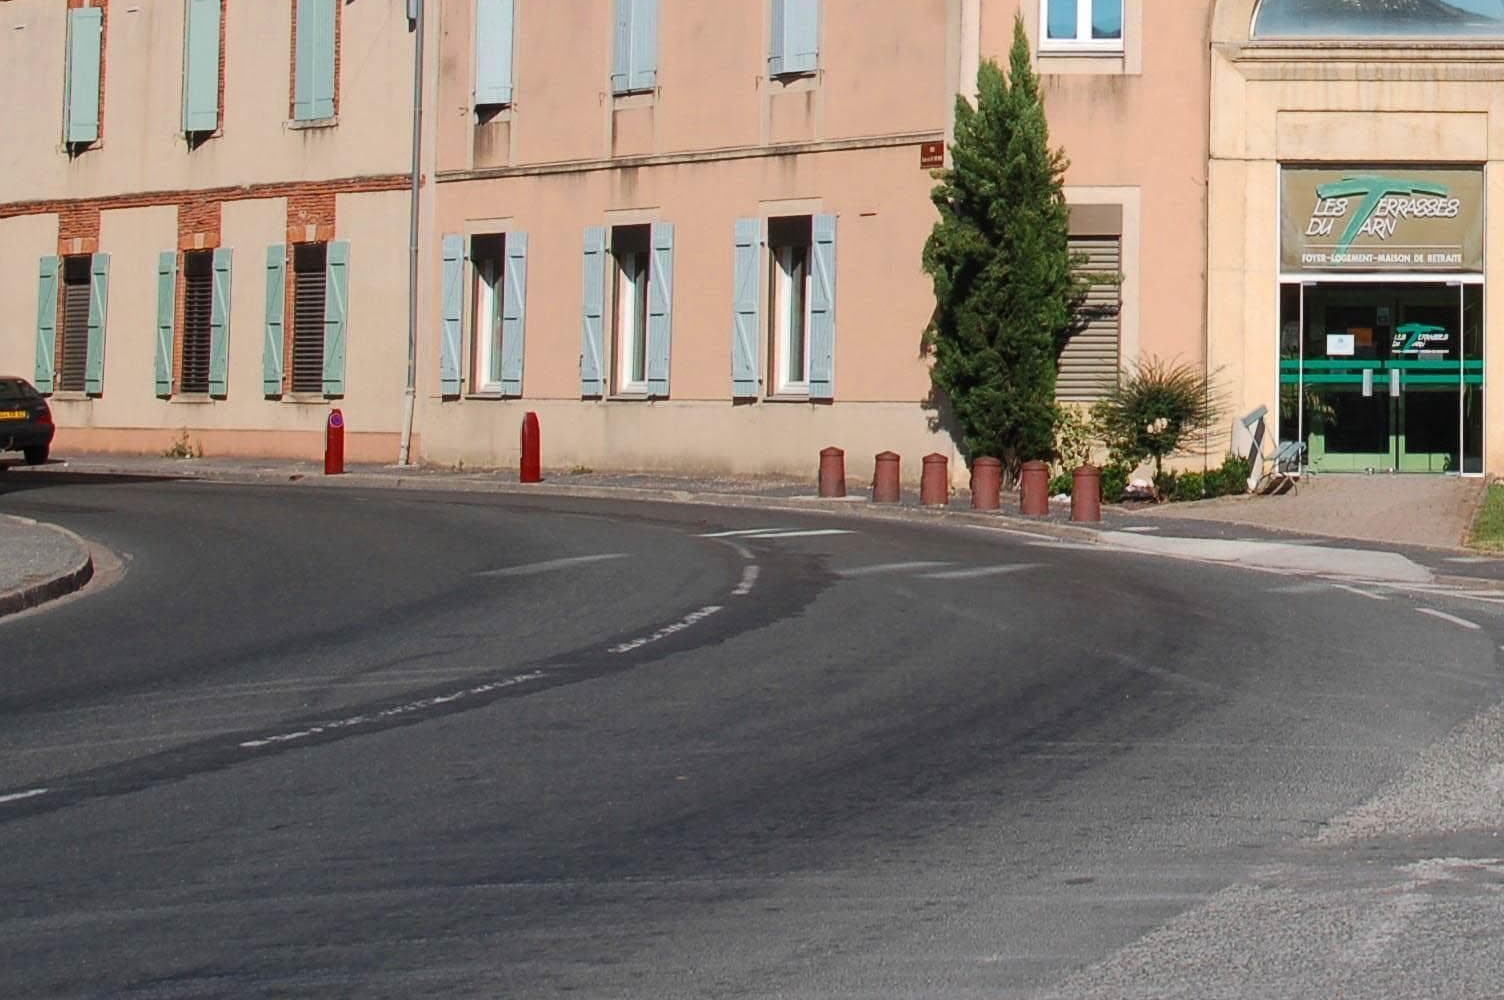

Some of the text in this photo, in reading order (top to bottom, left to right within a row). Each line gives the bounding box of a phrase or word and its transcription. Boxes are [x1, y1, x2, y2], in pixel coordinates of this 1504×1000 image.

[1313, 198, 1349, 217] LES
[1305, 218, 1334, 236] DU
[1414, 254, 1424, 263] DE
[1427, 254, 1462, 264] RETRAITE
